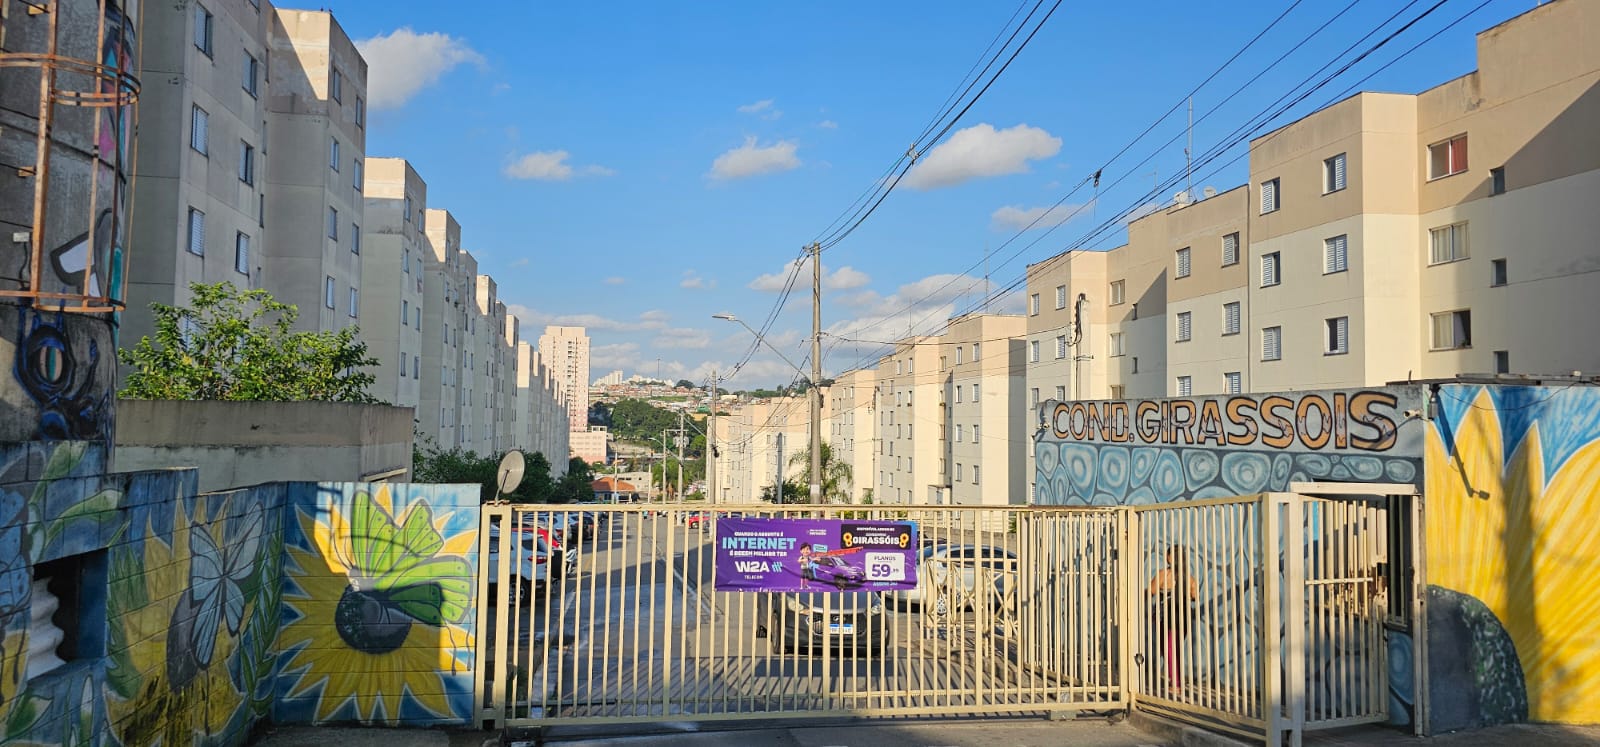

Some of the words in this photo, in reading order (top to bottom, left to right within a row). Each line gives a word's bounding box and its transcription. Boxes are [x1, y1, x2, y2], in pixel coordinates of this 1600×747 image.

[1135, 391, 1399, 452] GIRASSOIS
[722, 537, 797, 550] INTERNET
[852, 535, 900, 545] GIRASSÓIS
[734, 561, 770, 573] W2A
